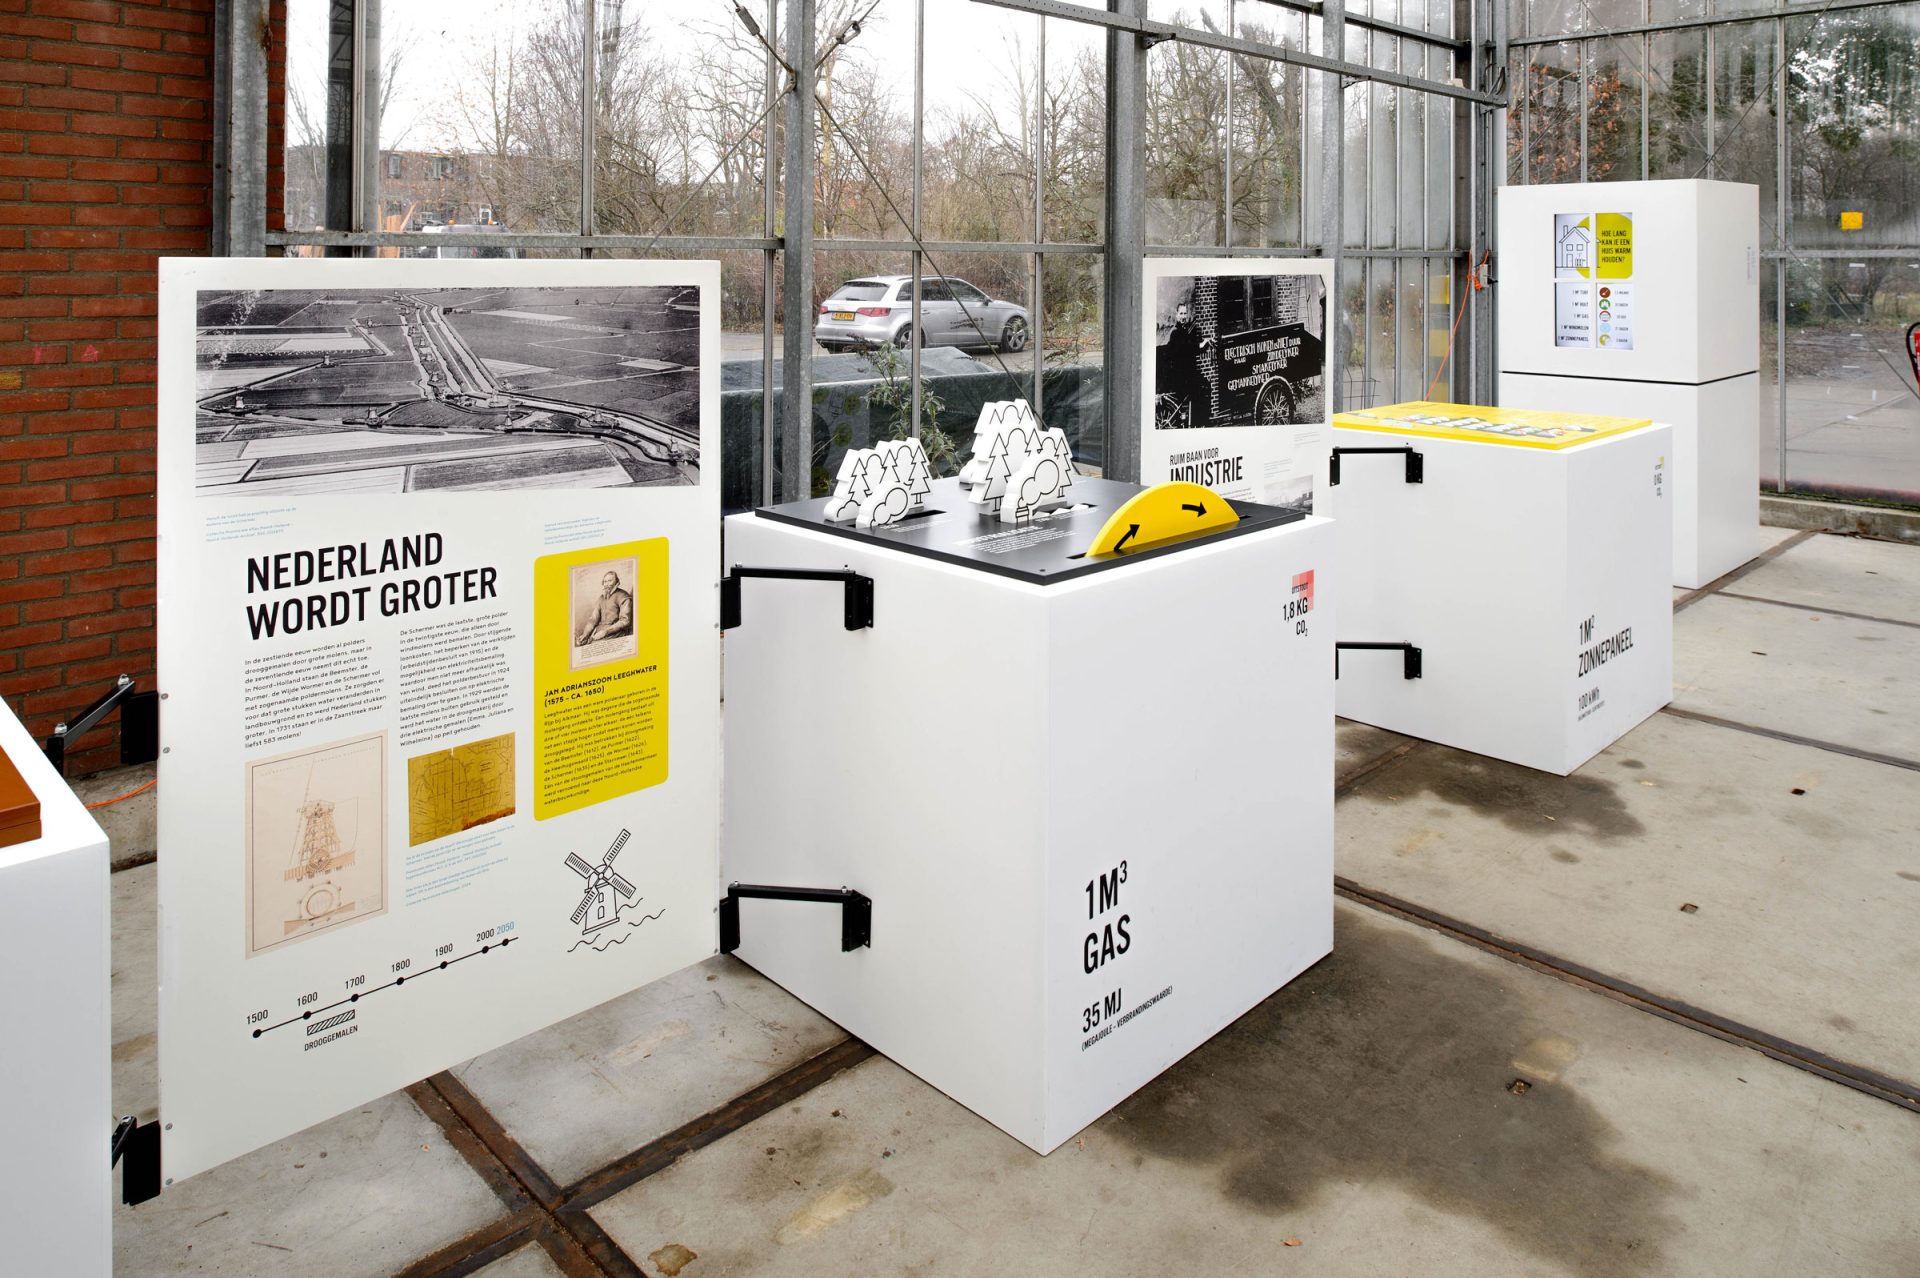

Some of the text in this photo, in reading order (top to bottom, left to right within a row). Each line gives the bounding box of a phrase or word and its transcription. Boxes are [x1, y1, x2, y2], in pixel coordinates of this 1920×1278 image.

[1170, 448, 1218, 466] RUIM BAAN VOOR
[247, 532, 443, 593] NEDERLAND
[246, 566, 497, 640] WORDT GROTER
[1283, 597, 1308, 623] 1,8 KG
[292, 657, 306, 665] door
[1579, 626, 1633, 678] ZONNEPANEEL
[544, 665, 657, 697] JAN ADRIANSZOON LEEGHWATER
[245, 703, 257, 711] met
[544, 697, 564, 708] (1575
[585, 685, 605, 696] 1650)
[314, 706, 329, 714] werd
[276, 723, 290, 731] 1731
[476, 921, 514, 943] 2000 2050
[435, 943, 453, 957] 1900
[1084, 914, 1130, 974] GAS
[391, 958, 410, 973] 1800
[345, 975, 365, 989] 1700
[297, 992, 318, 1007] 1600
[1083, 988, 1121, 1033] 35 MJ
[246, 1010, 268, 1025] 1500
[1082, 1024, 1112, 1052] (MEGAJOULE
[1117, 985, 1172, 1027] VERBRANDINGSWAARDE)
[304, 1025, 358, 1051] DROOGGEMALEN
